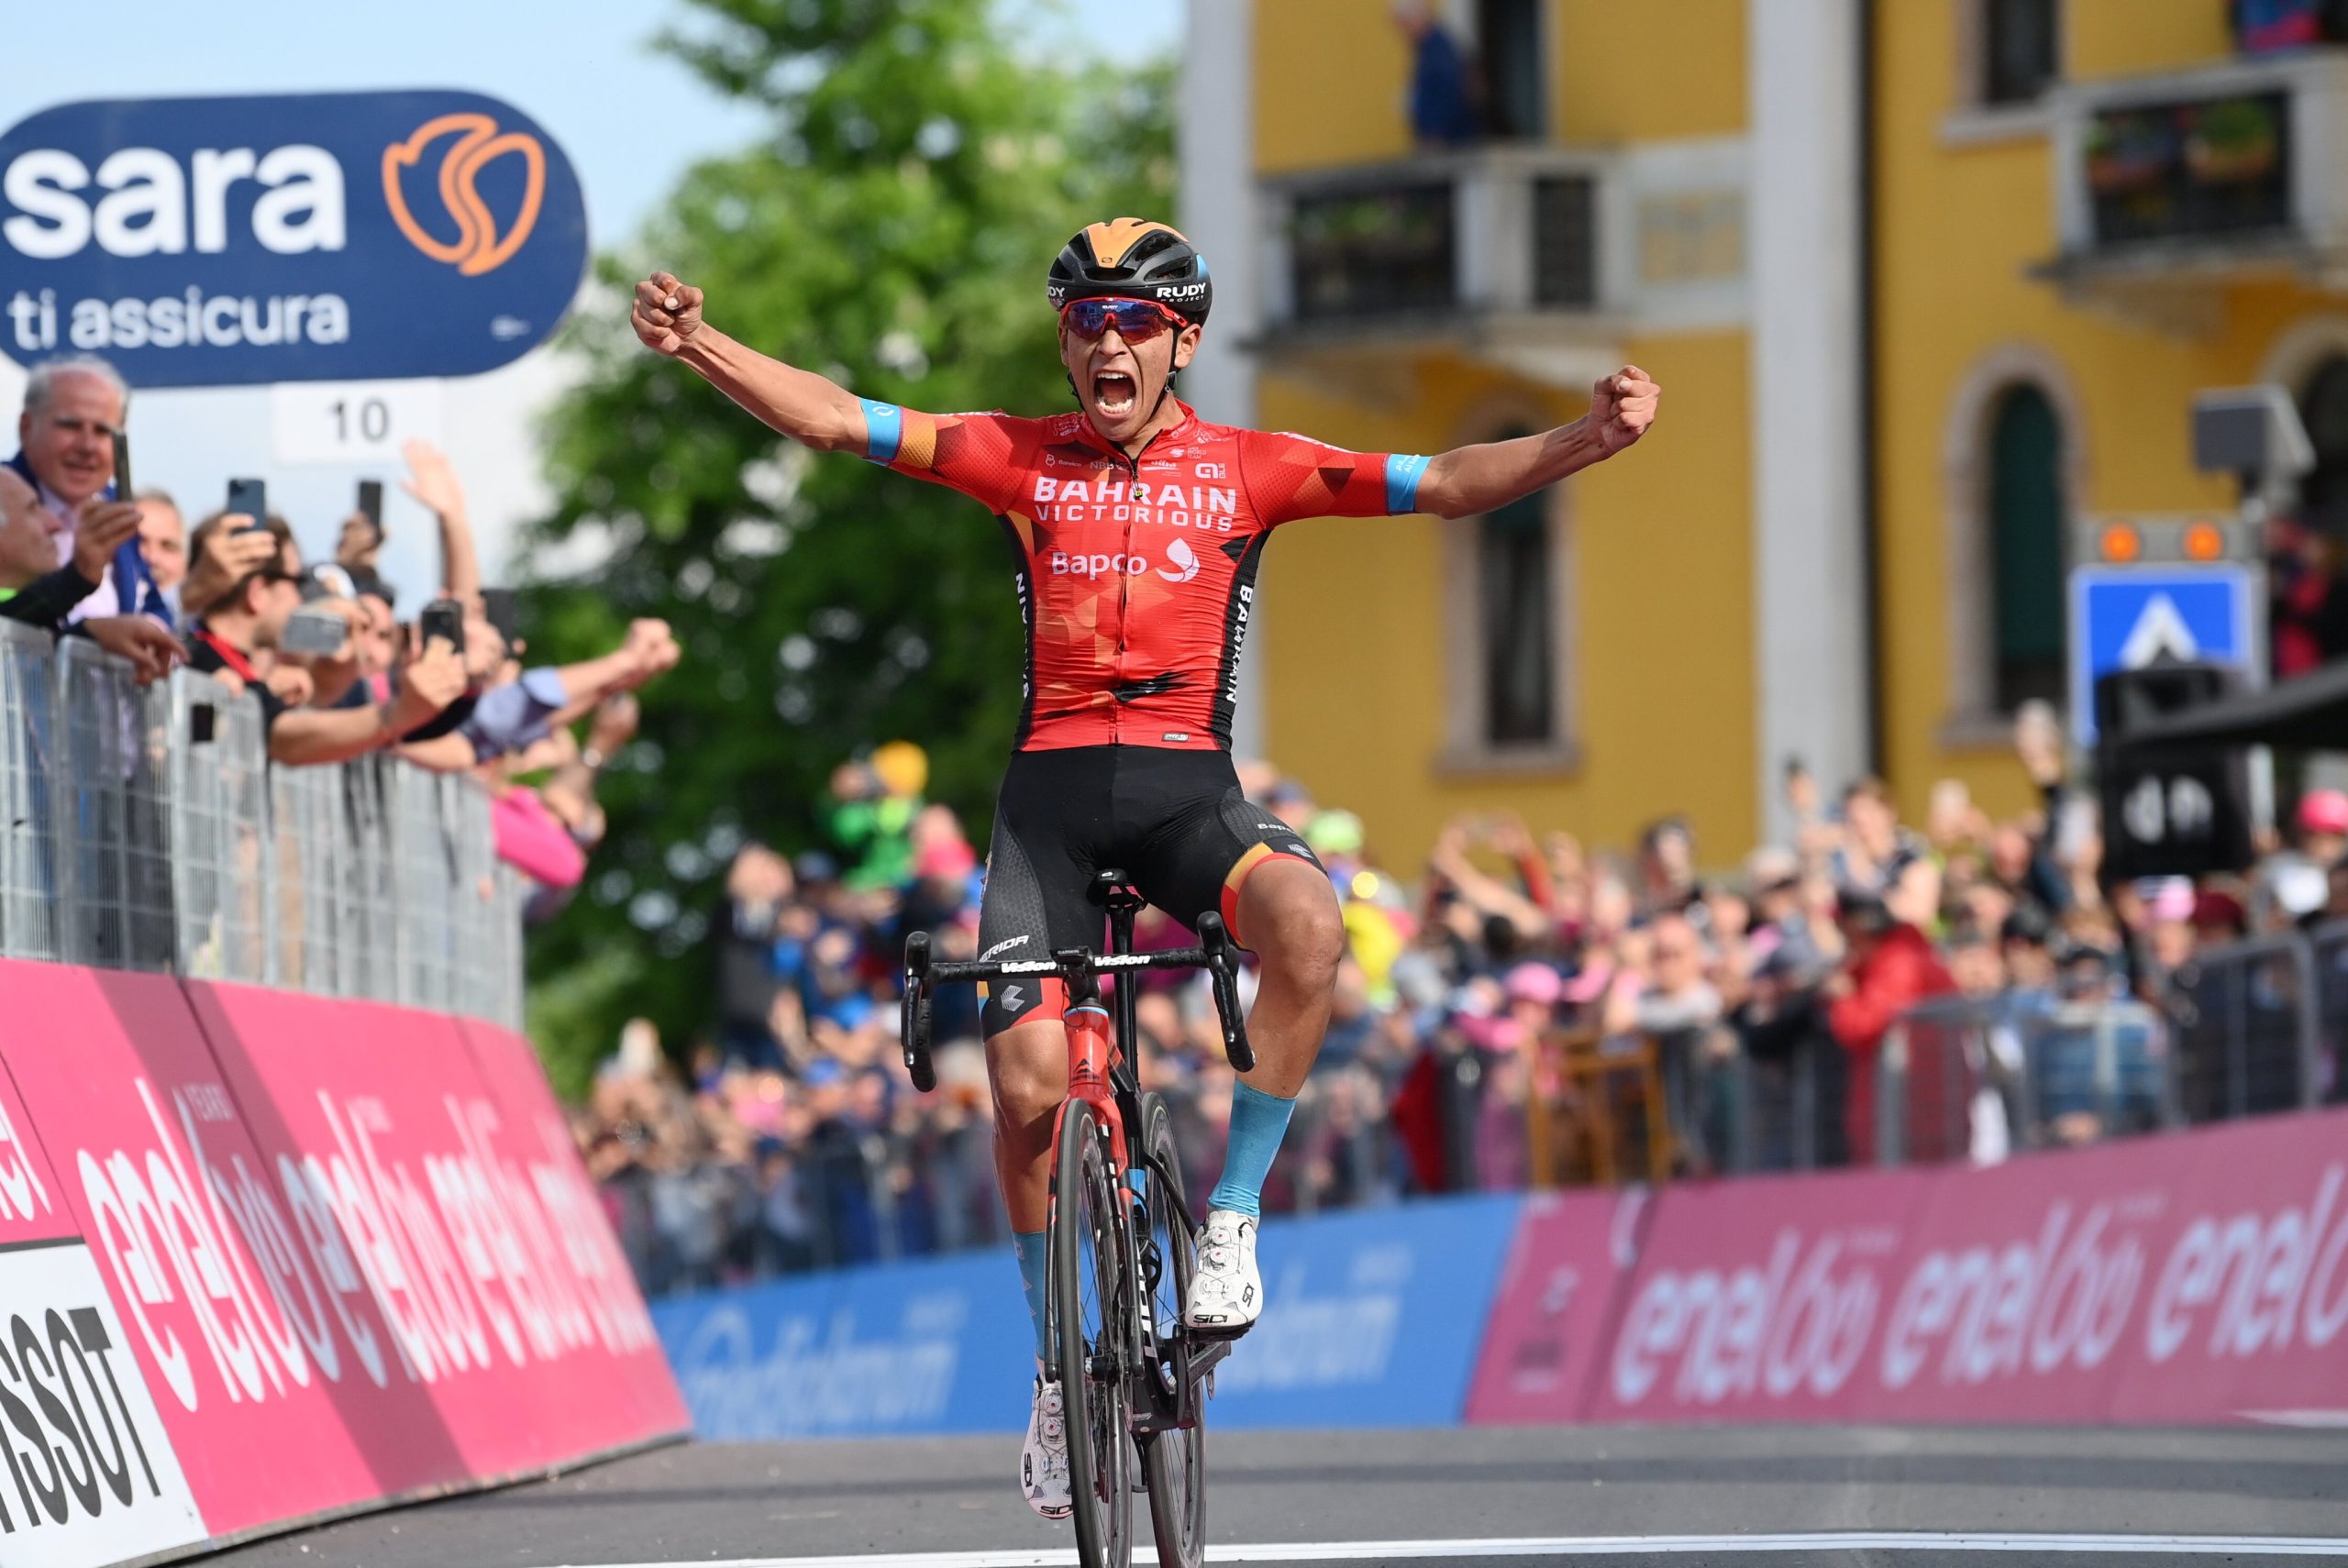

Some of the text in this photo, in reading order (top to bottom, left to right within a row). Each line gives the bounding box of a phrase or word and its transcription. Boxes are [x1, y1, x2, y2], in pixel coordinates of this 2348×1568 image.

[2, 145, 347, 259] sara
[1157, 282, 1207, 298] RUDY
[7, 285, 349, 349] ti assicura
[330, 398, 390, 442] 10
[1034, 476, 1236, 513] BAHRAIN
[1035, 504, 1232, 532] VICTORIOUS
[1052, 552, 1147, 580] Bapco
[979, 934, 1029, 962] ERIDA
